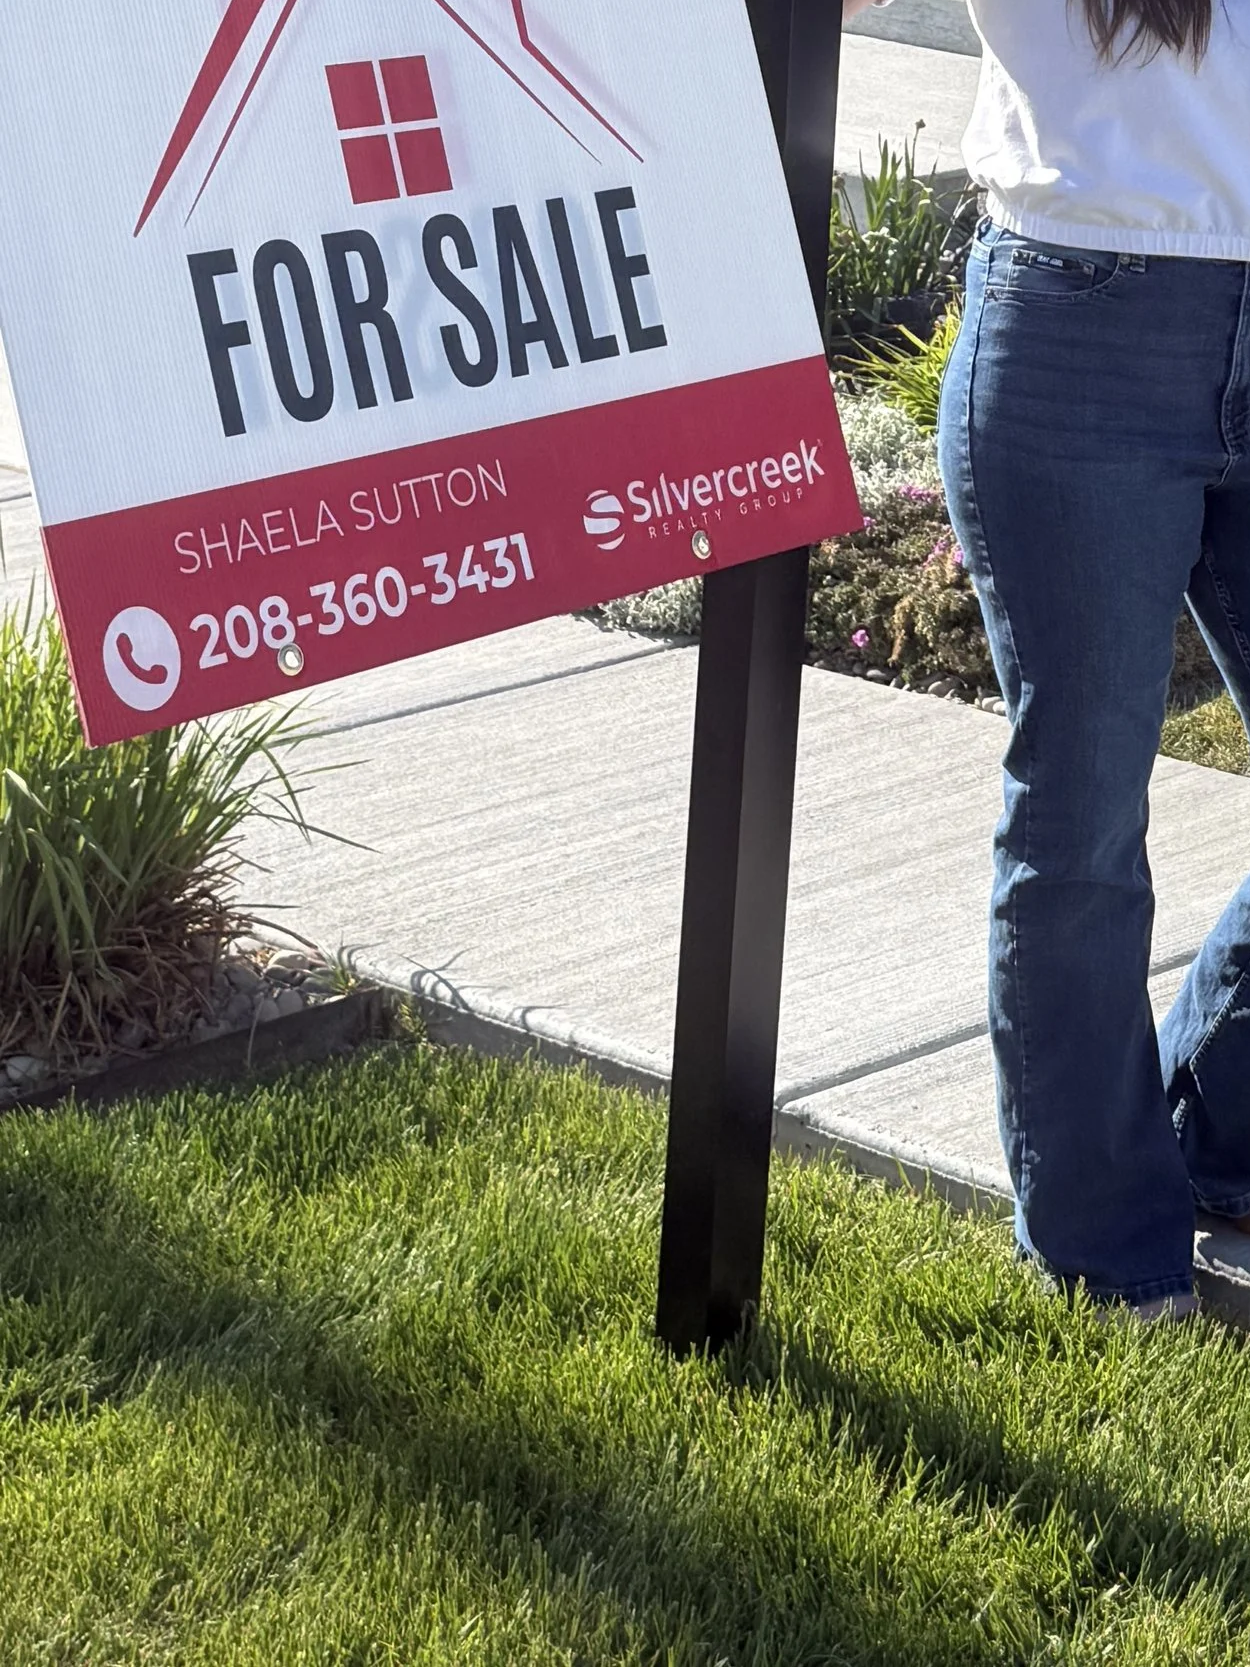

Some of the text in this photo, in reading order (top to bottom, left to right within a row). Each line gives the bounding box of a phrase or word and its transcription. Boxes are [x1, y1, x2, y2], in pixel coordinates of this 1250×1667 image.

[186, 186, 668, 437] FOR SALE
[174, 459, 508, 574] SHAELA SUTTON
[627, 439, 825, 523] Silvercreek
[649, 488, 804, 539] REALTY GROUP
[188, 532, 536, 670] 208-360-3431
